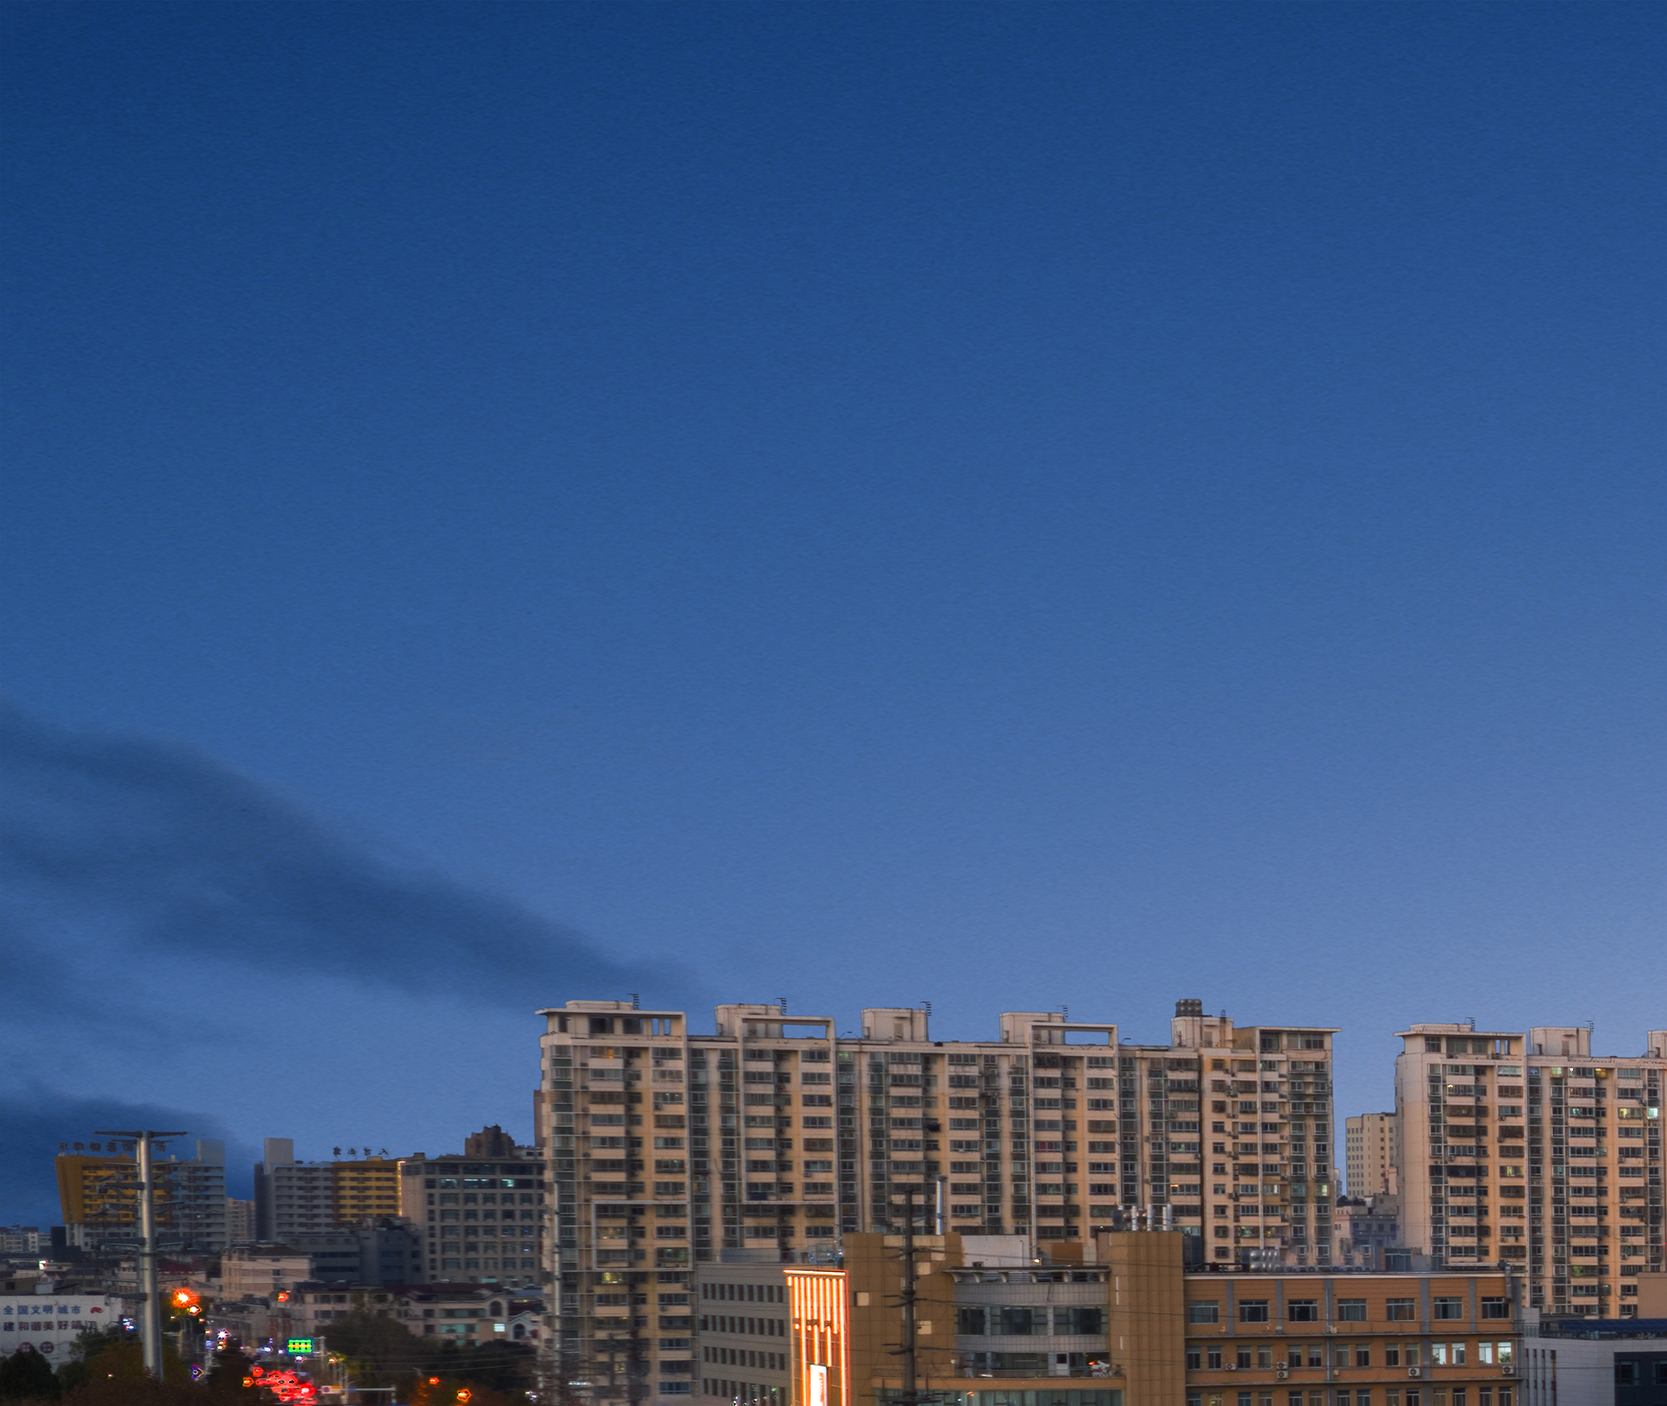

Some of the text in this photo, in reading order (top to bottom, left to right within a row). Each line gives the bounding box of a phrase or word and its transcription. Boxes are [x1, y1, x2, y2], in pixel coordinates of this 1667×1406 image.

[3, 1304, 81, 1315] 全国文明城市
